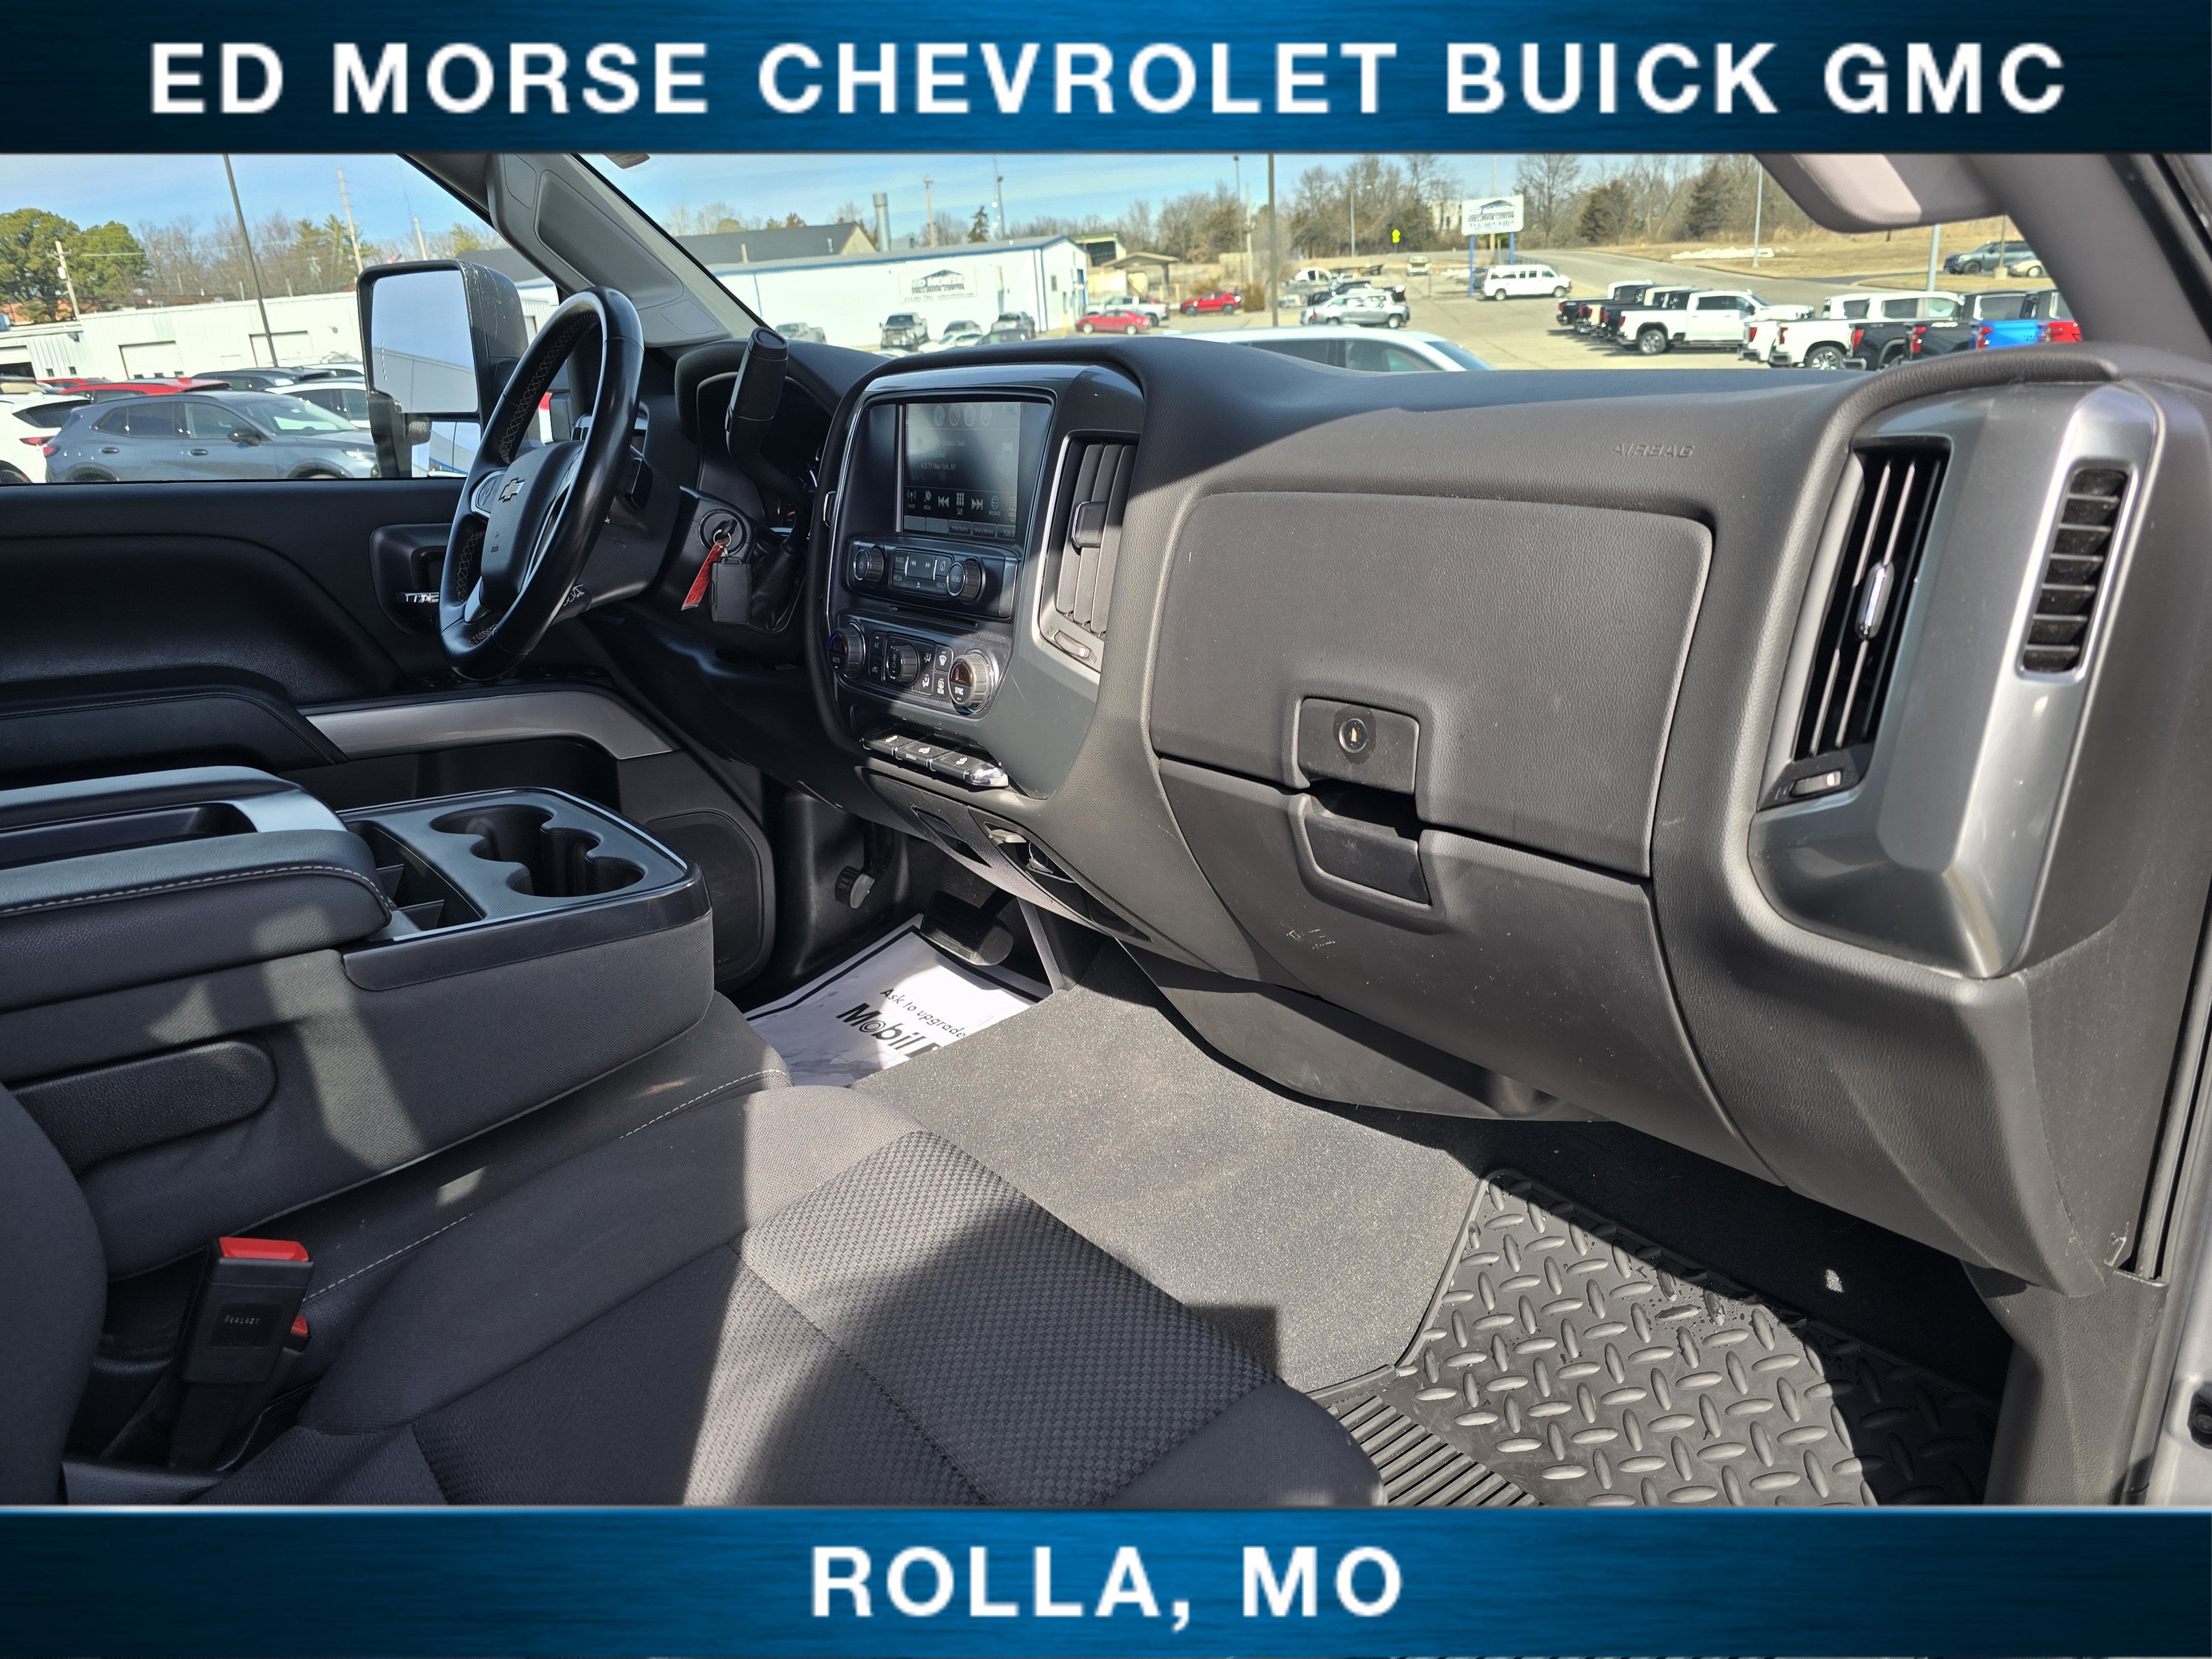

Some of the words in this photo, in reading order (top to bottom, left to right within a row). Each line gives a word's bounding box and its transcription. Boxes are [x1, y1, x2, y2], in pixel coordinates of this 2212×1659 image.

[1610, 444, 1695, 458] AIRBAG
[951, 575, 961, 583] MENU
[836, 1002, 927, 1051] Mobil
[879, 988, 905, 1004] Ask
[902, 1001, 917, 1011] to
[916, 1010, 966, 1039] upgrade
